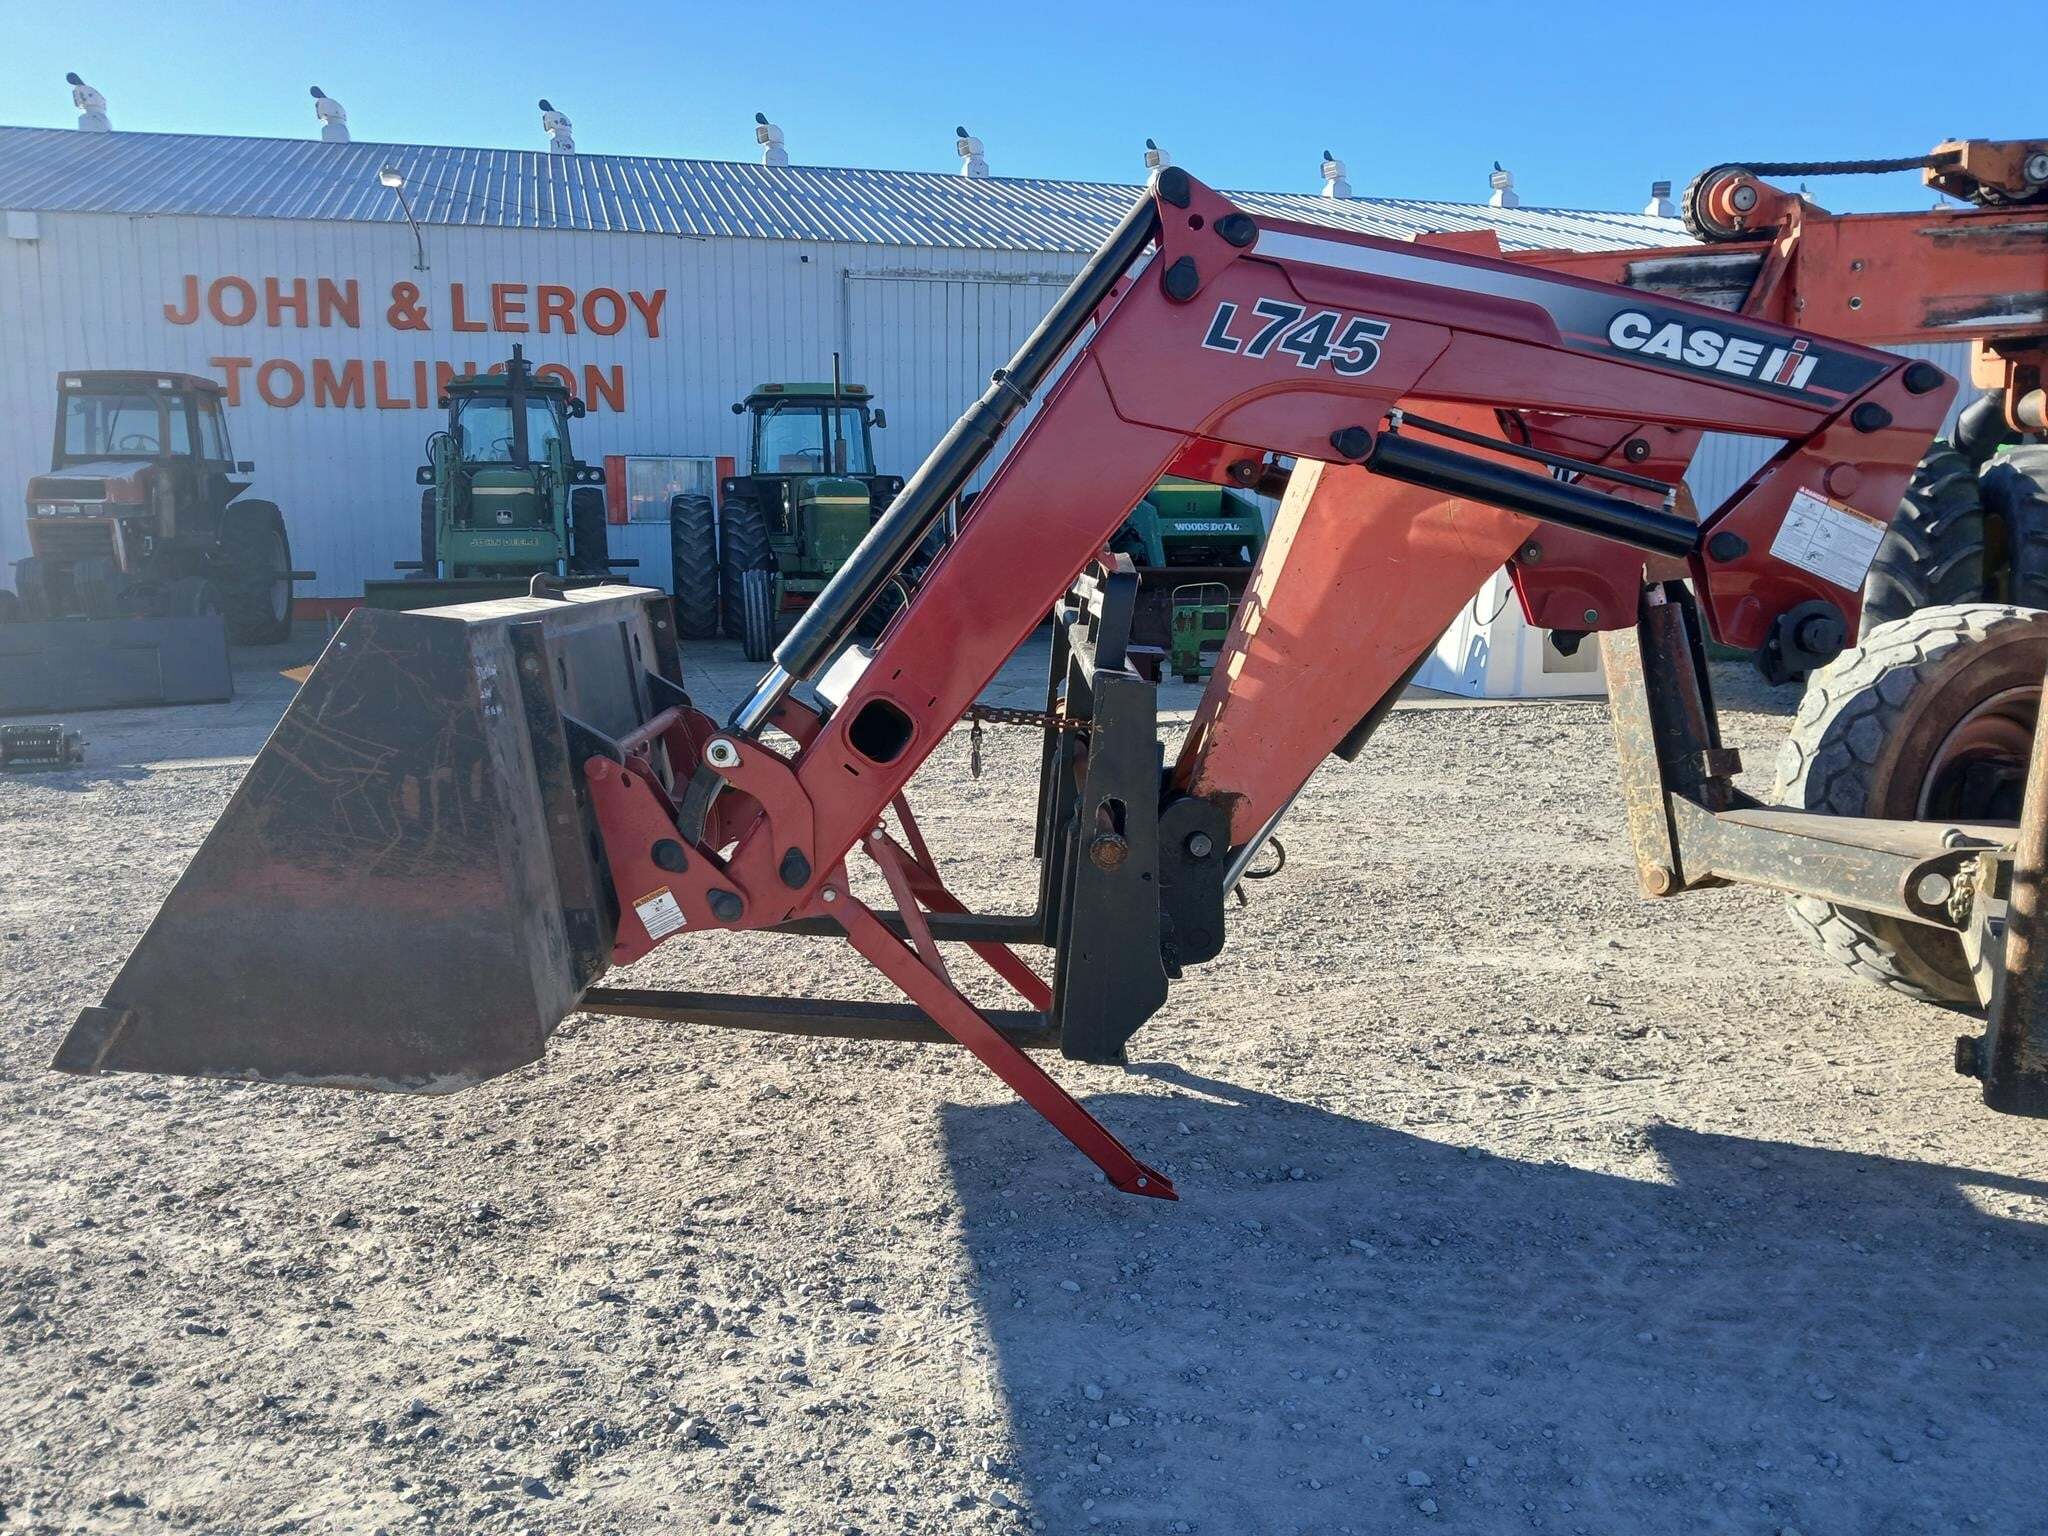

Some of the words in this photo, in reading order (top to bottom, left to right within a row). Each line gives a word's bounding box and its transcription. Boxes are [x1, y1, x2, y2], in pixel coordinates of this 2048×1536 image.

[164, 274, 360, 329] JOHN
[386, 281, 432, 331] &
[450, 283, 667, 338] LEROY
[1201, 297, 1392, 377] L745
[1608, 312, 1765, 377] CASE
[211, 356, 625, 413] TOMLINON
[1174, 522, 1210, 531] WOODS
